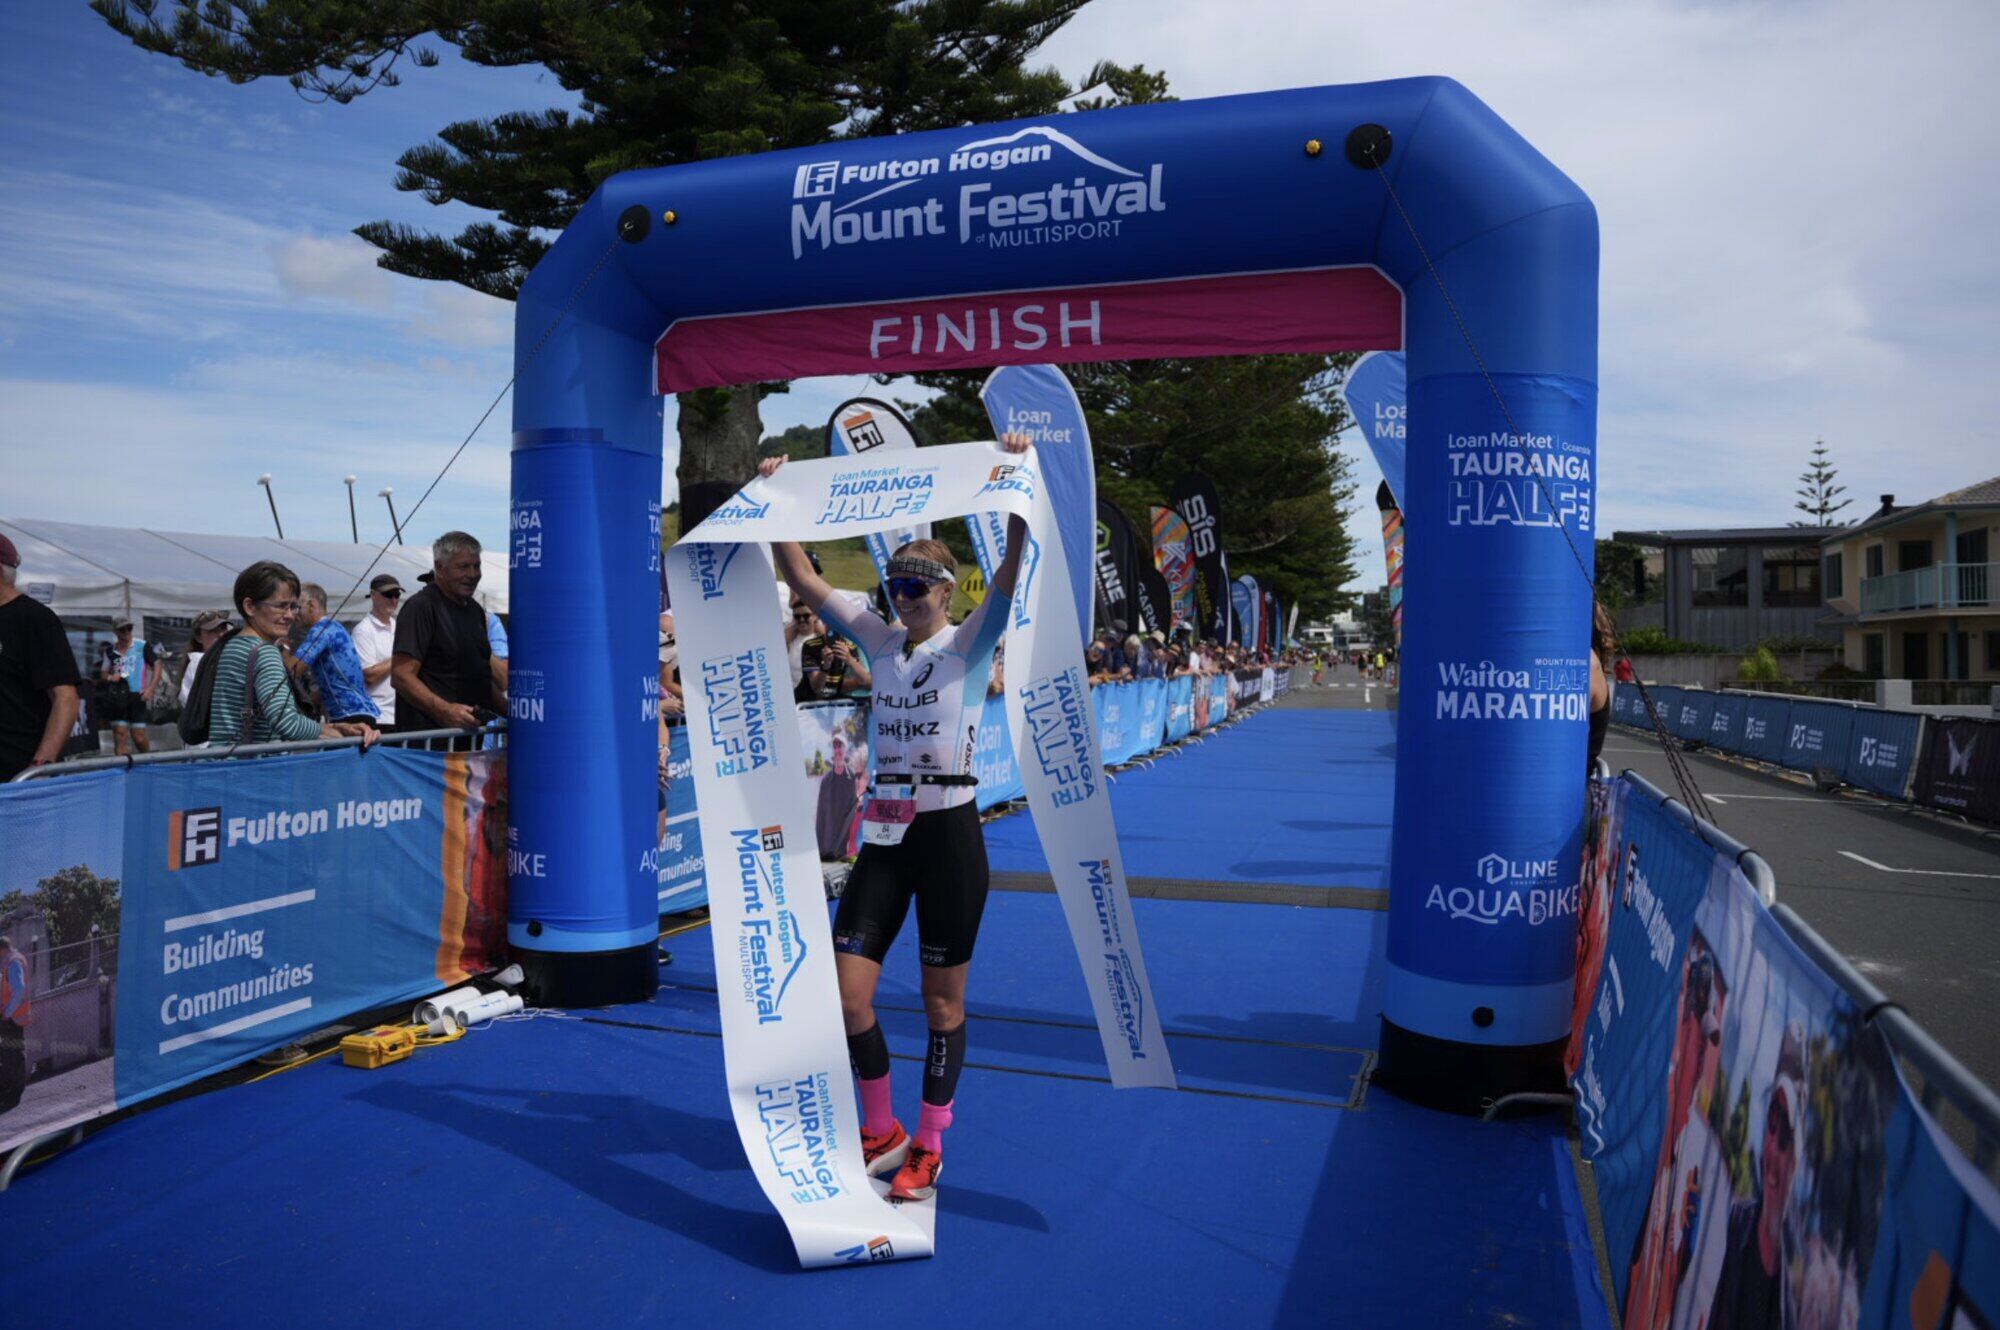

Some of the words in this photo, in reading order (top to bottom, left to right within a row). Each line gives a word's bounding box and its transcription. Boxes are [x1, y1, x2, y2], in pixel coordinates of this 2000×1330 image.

[842, 157, 938, 184] Fulton
[949, 144, 1051, 172] Hogan
[791, 199, 945, 259] Mount
[958, 164, 1166, 244] Festival
[989, 220, 1122, 248] MULTISPORT
[870, 300, 1101, 358] FINISH
[1008, 406, 1051, 423] Loan
[1449, 434, 1488, 448] Loan
[1491, 433, 1552, 448] Market
[830, 474, 933, 497] TAURANGA
[832, 471, 860, 482] Loan
[860, 467, 899, 478] Market
[1449, 453, 1590, 482] TAURANGA
[816, 493, 912, 524] HALF
[908, 491, 931, 515] TRI
[1448, 480, 1577, 528] HALF
[1579, 489, 1590, 531] TRI
[528, 533, 542, 568] TRI
[1096, 550, 1126, 603] LINE
[755, 647, 767, 677] Loan
[1439, 660, 1529, 689] Waitoa
[1535, 669, 1588, 690] HALF
[702, 655, 746, 756] HALF
[736, 650, 768, 771] TAURANGA
[760, 678, 776, 722] Market
[876, 690, 938, 709] HUUB
[1436, 691, 1587, 721] MARATHON
[1020, 676, 1078, 785] HALF
[1051, 786, 1084, 809] TRI
[1052, 670, 1095, 799] TAURANGA
[715, 757, 749, 778] TRI
[228, 809, 328, 847] Fulton
[337, 798, 423, 829] Hogan
[730, 829, 764, 914] Mount
[770, 853, 785, 905] Fulton
[1511, 860, 1558, 877] LINE
[1425, 884, 1580, 926] AQUABIKE
[164, 929, 264, 974] Building
[777, 910, 793, 963] Hogan
[739, 936, 755, 1003] MULTISPORT
[742, 919, 782, 1025] Festival
[1079, 860, 1112, 948] Mount
[1104, 954, 1146, 1060] Festival
[161, 963, 313, 1025] Communities
[1105, 969, 1127, 1037] MULTISPORT
[816, 1072, 829, 1103] Loan
[756, 1080, 814, 1187] HALF
[791, 1187, 828, 1205] TRI
[795, 1075, 840, 1199] TAURANGA
[819, 1104, 837, 1150] Market
